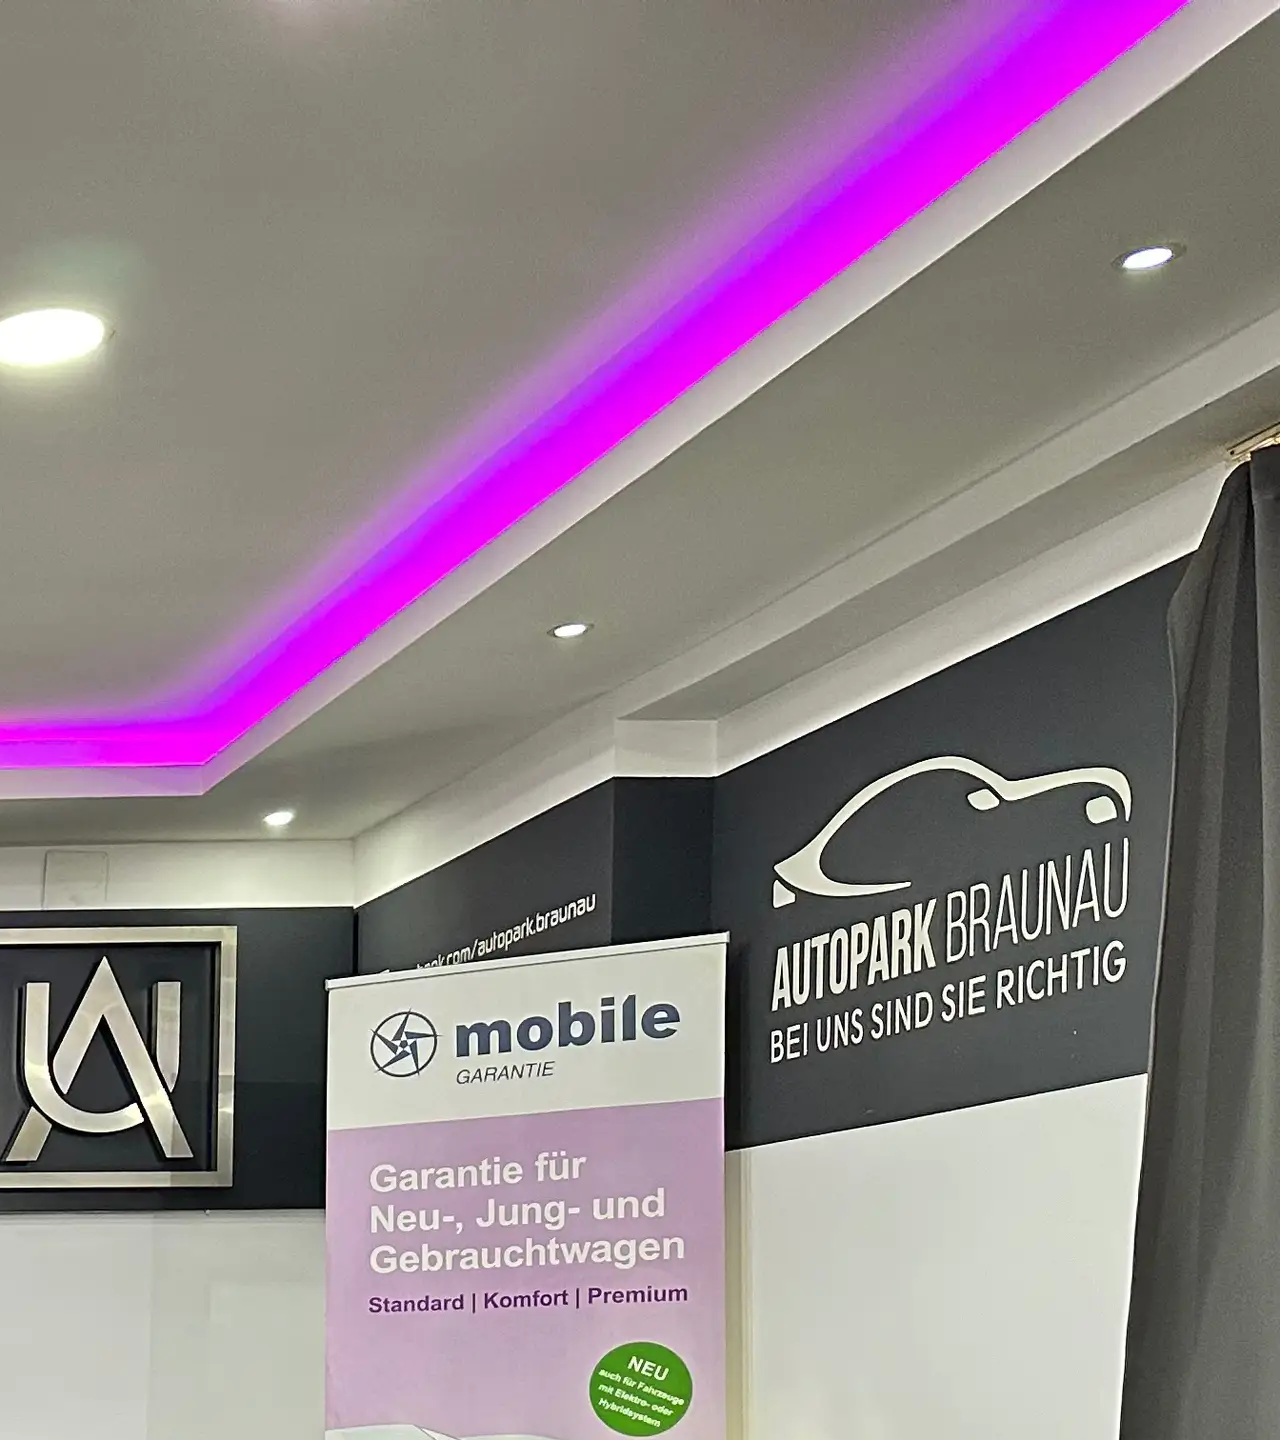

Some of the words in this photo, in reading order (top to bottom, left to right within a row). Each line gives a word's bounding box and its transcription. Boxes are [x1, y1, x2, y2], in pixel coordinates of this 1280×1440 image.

[771, 899, 937, 1012] AUTOPARK
[946, 838, 1130, 964] BRAUNAU
[770, 1022, 809, 1063] BEI
[816, 1009, 864, 1052] UNS
[871, 991, 934, 1040] SIND
[941, 974, 987, 1022] SIE
[996, 939, 1127, 1010] RICHTIG
[455, 994, 681, 1058] mobile
[455, 1060, 556, 1085] GARANTIE
[369, 1156, 523, 1193] Garantie
[534, 1150, 588, 1182] für
[369, 1204, 463, 1234] Neu-,
[476, 1198, 581, 1231] Jung-
[592, 1187, 665, 1221] und
[369, 1236, 685, 1274] Gebrauchtwagen
[368, 1293, 465, 1314] Standard
[483, 1289, 570, 1311] Komfort
[587, 1286, 689, 1306] Premium
[627, 1355, 670, 1381] NEU
[598, 1369, 622, 1383] auch
[622, 1376, 637, 1388] für
[637, 1381, 685, 1406] Fahrzeuge
[598, 1384, 614, 1395] mit
[614, 1388, 651, 1408] Elektro-
[651, 1404, 674, 1416] oder
[598, 1397, 661, 1428] Hybridsystem
